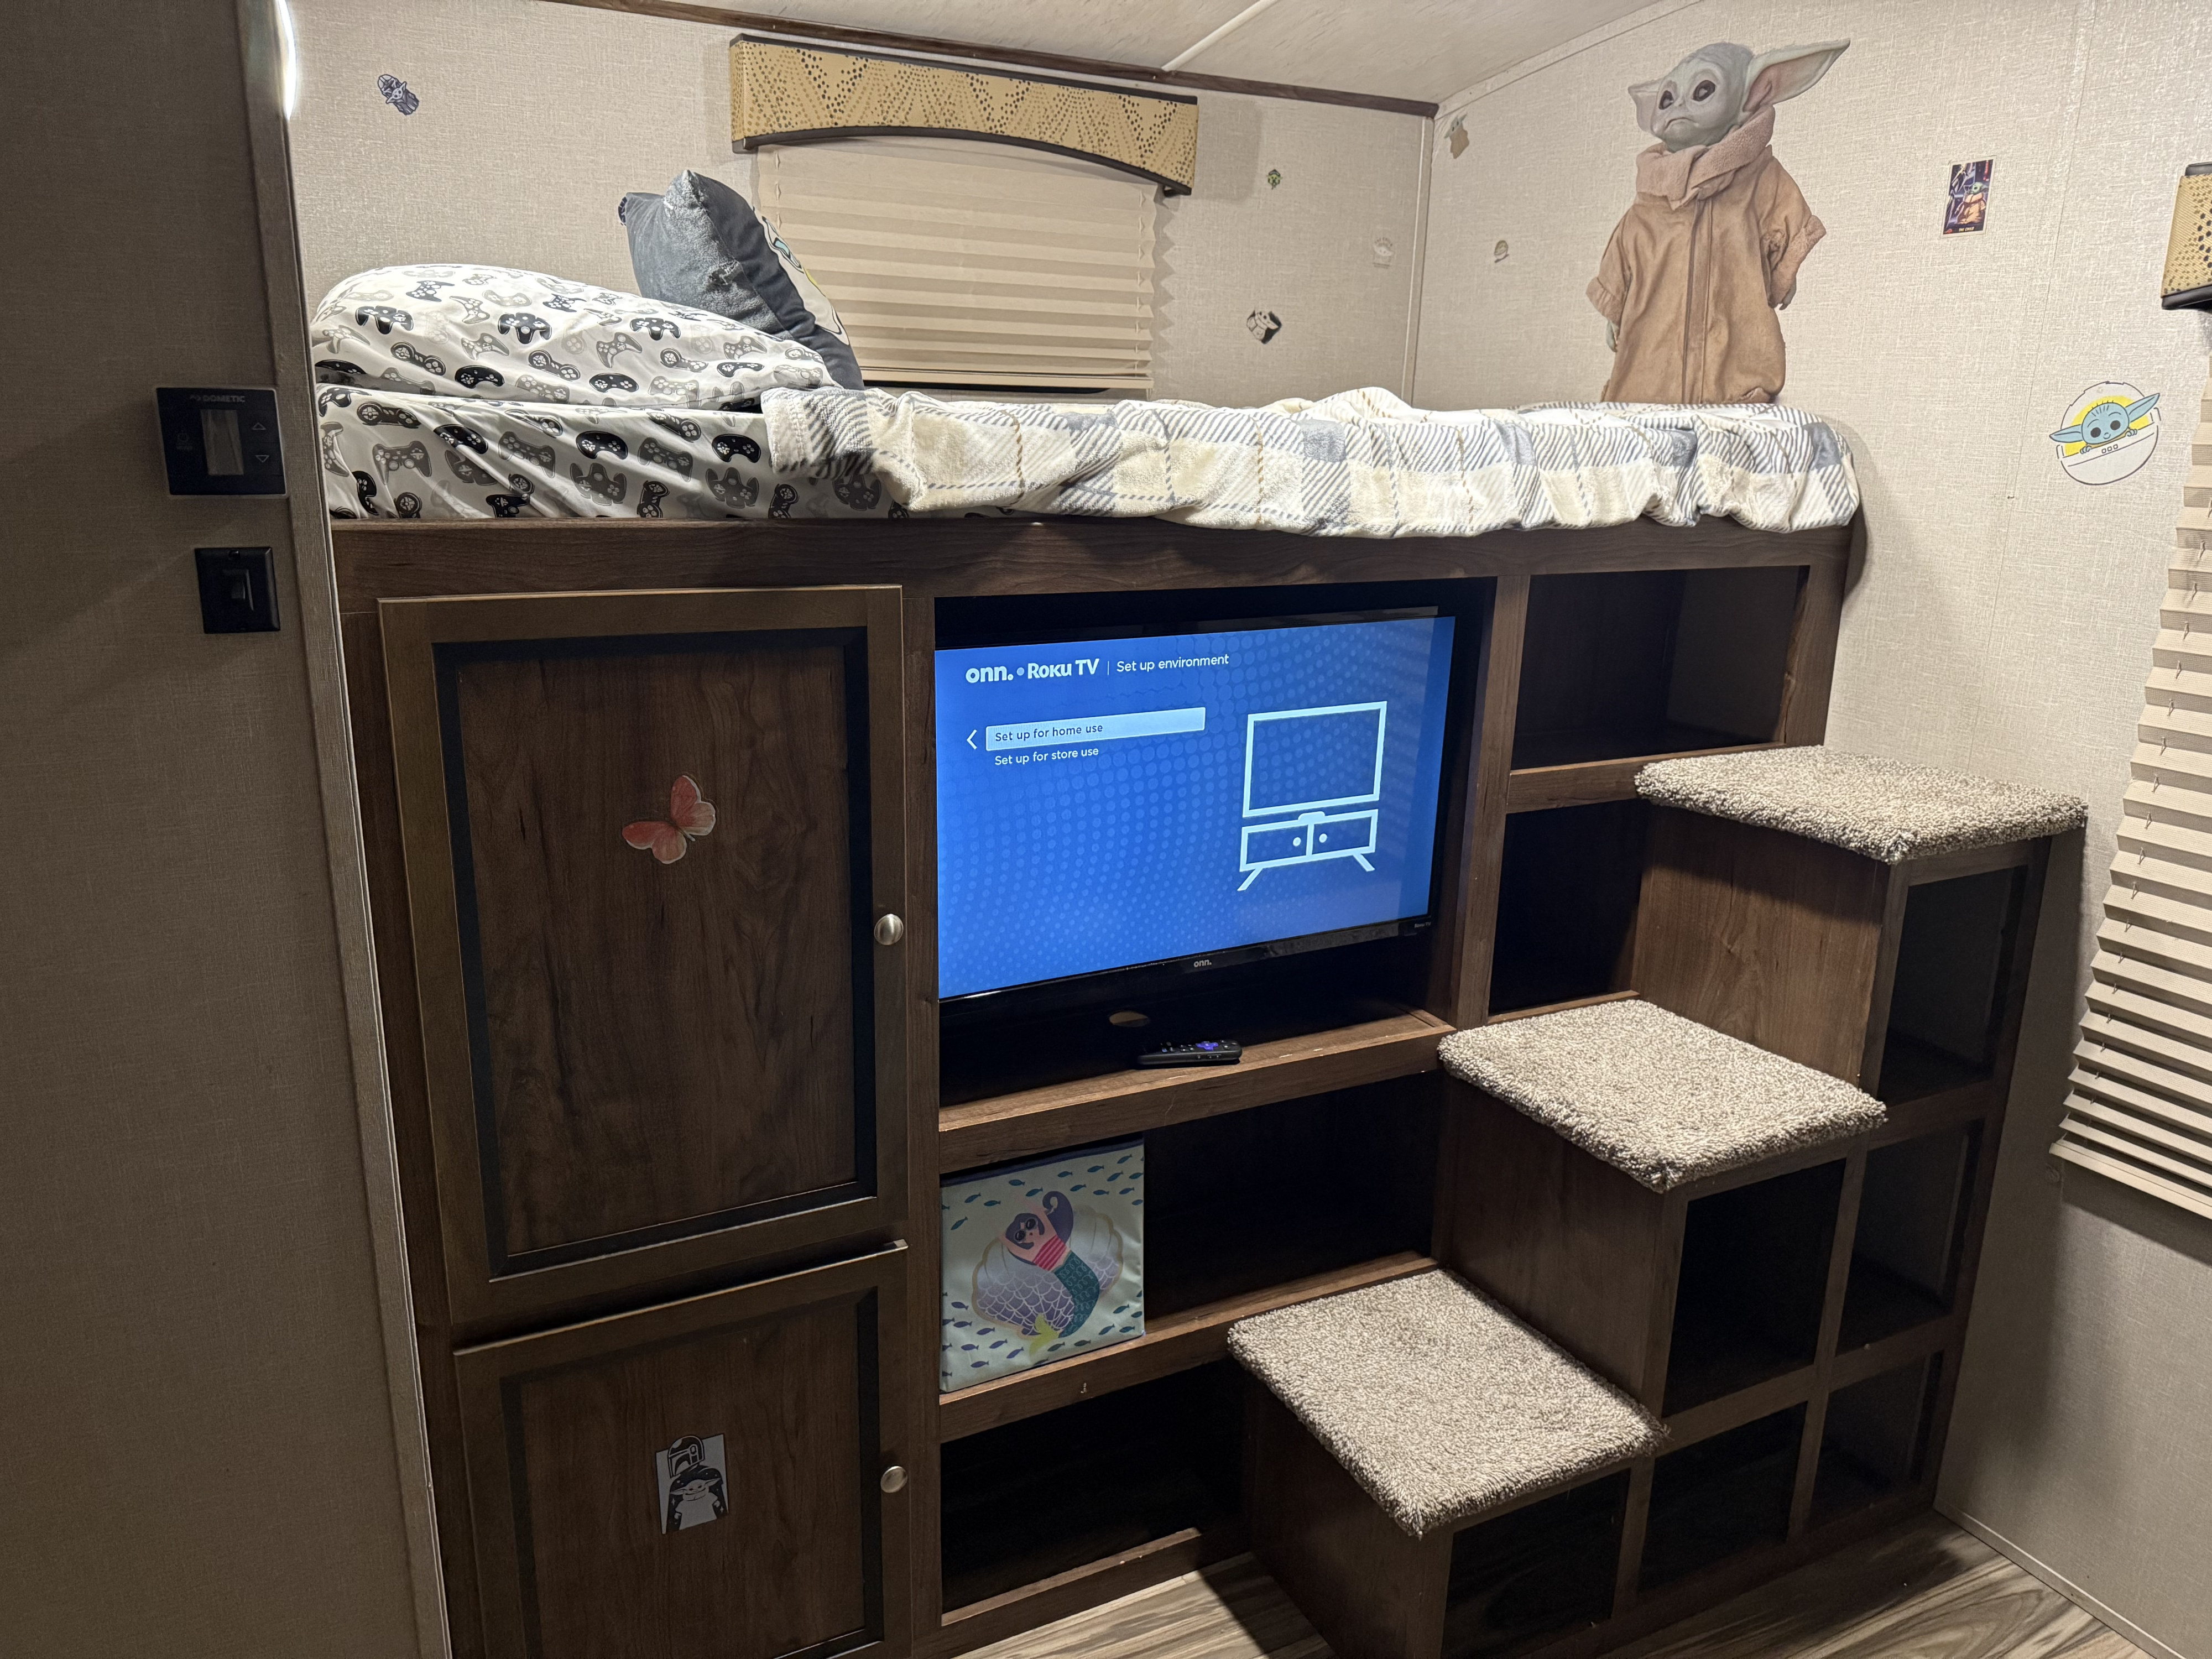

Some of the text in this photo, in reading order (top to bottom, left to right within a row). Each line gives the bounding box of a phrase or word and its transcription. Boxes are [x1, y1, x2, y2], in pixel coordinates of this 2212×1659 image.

[202, 394, 246, 403] DOMETIC
[966, 665, 1014, 684] onn.
[1075, 658, 1099, 676] TV
[1116, 660, 1136, 672] Set
[1140, 662, 1155, 672] up
[1159, 653, 1229, 669] environment
[995, 724, 1103, 742] Set up for home use
[995, 747, 1099, 766] Set up for store use
[1193, 959, 1212, 968] onn.
